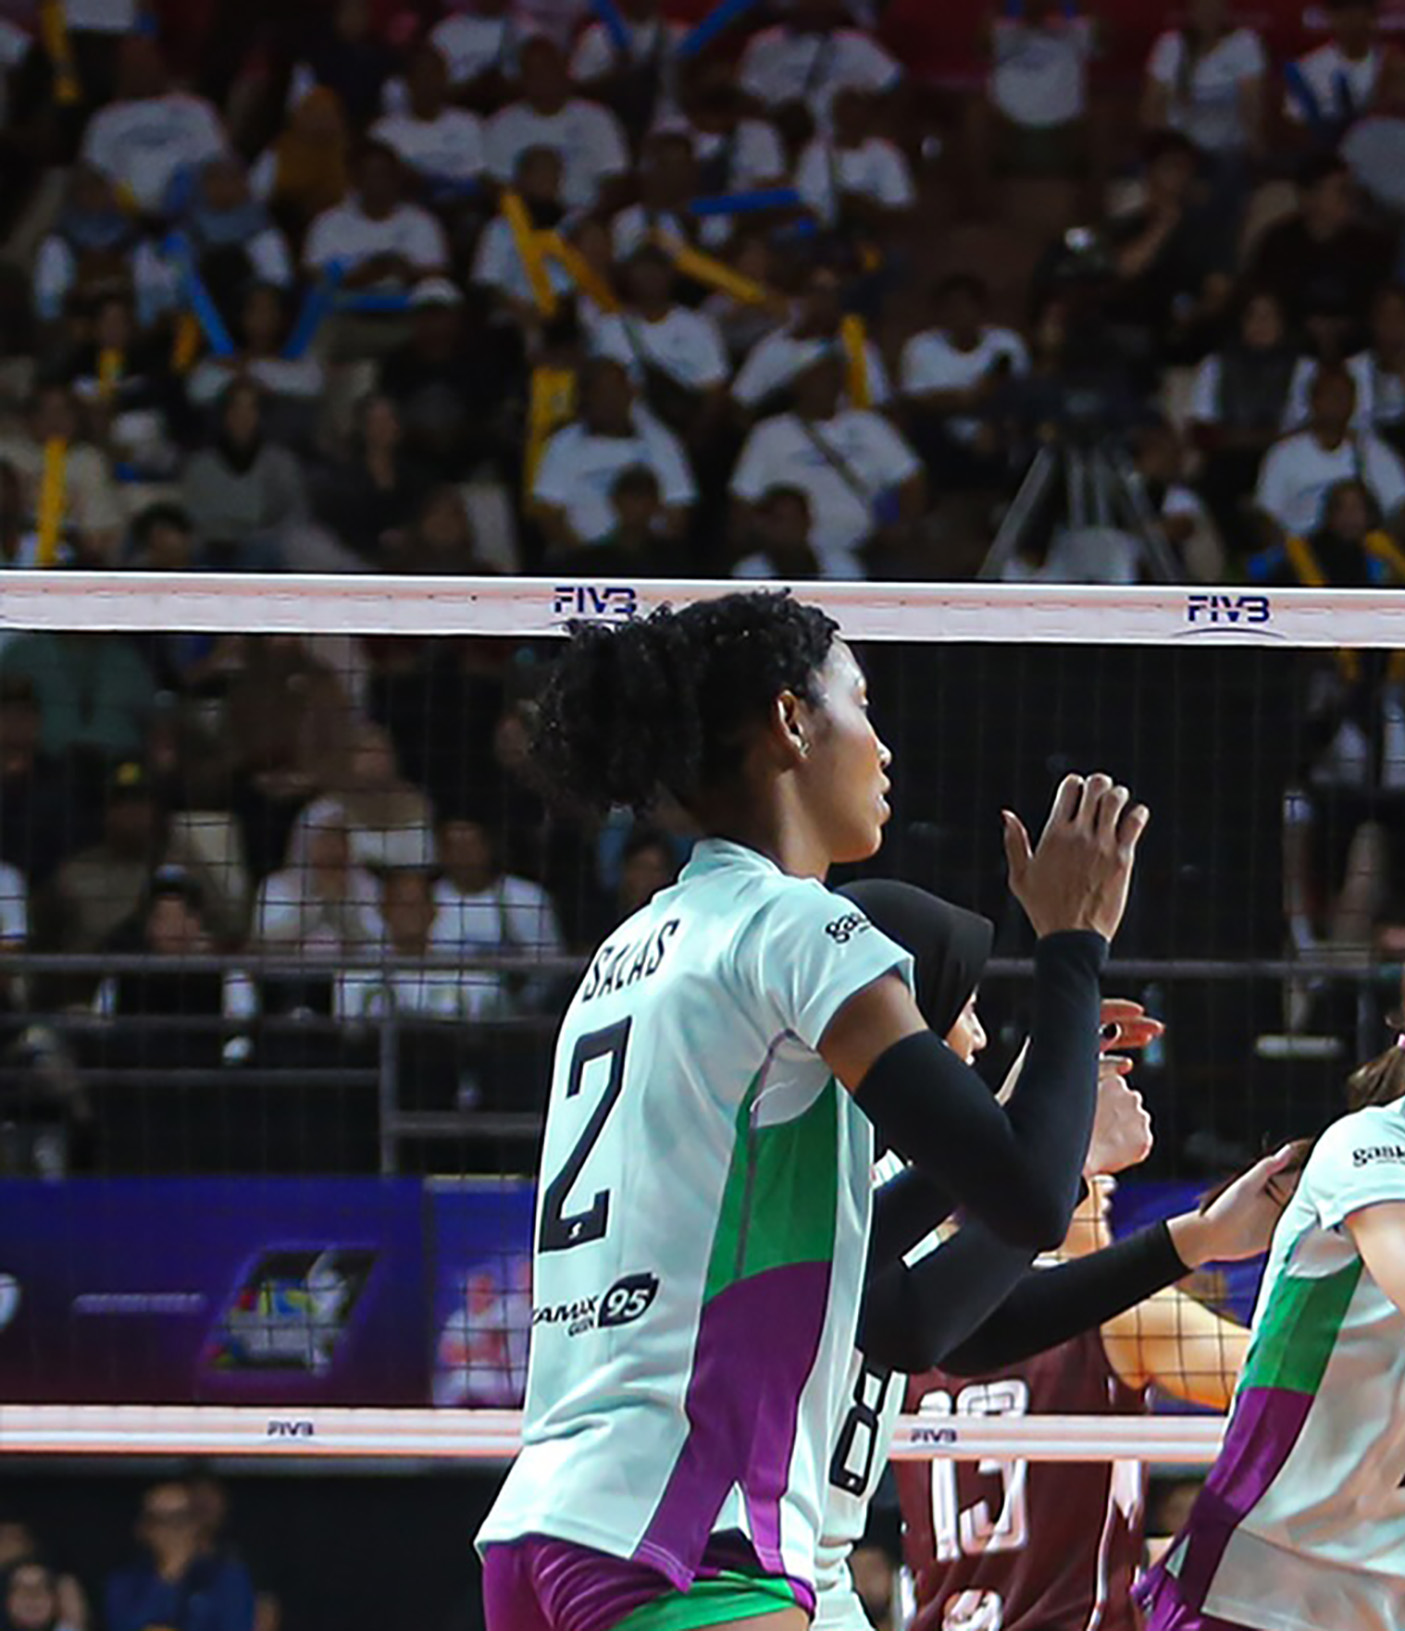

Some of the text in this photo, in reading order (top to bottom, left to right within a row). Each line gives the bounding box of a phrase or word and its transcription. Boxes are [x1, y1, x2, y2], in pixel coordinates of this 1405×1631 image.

[554, 586, 637, 613] FIVB
[1187, 595, 1270, 622] FIVB
[581, 918, 681, 1003] SALAS
[538, 1016, 632, 1254] 2
[607, 1288, 651, 1318] 95
